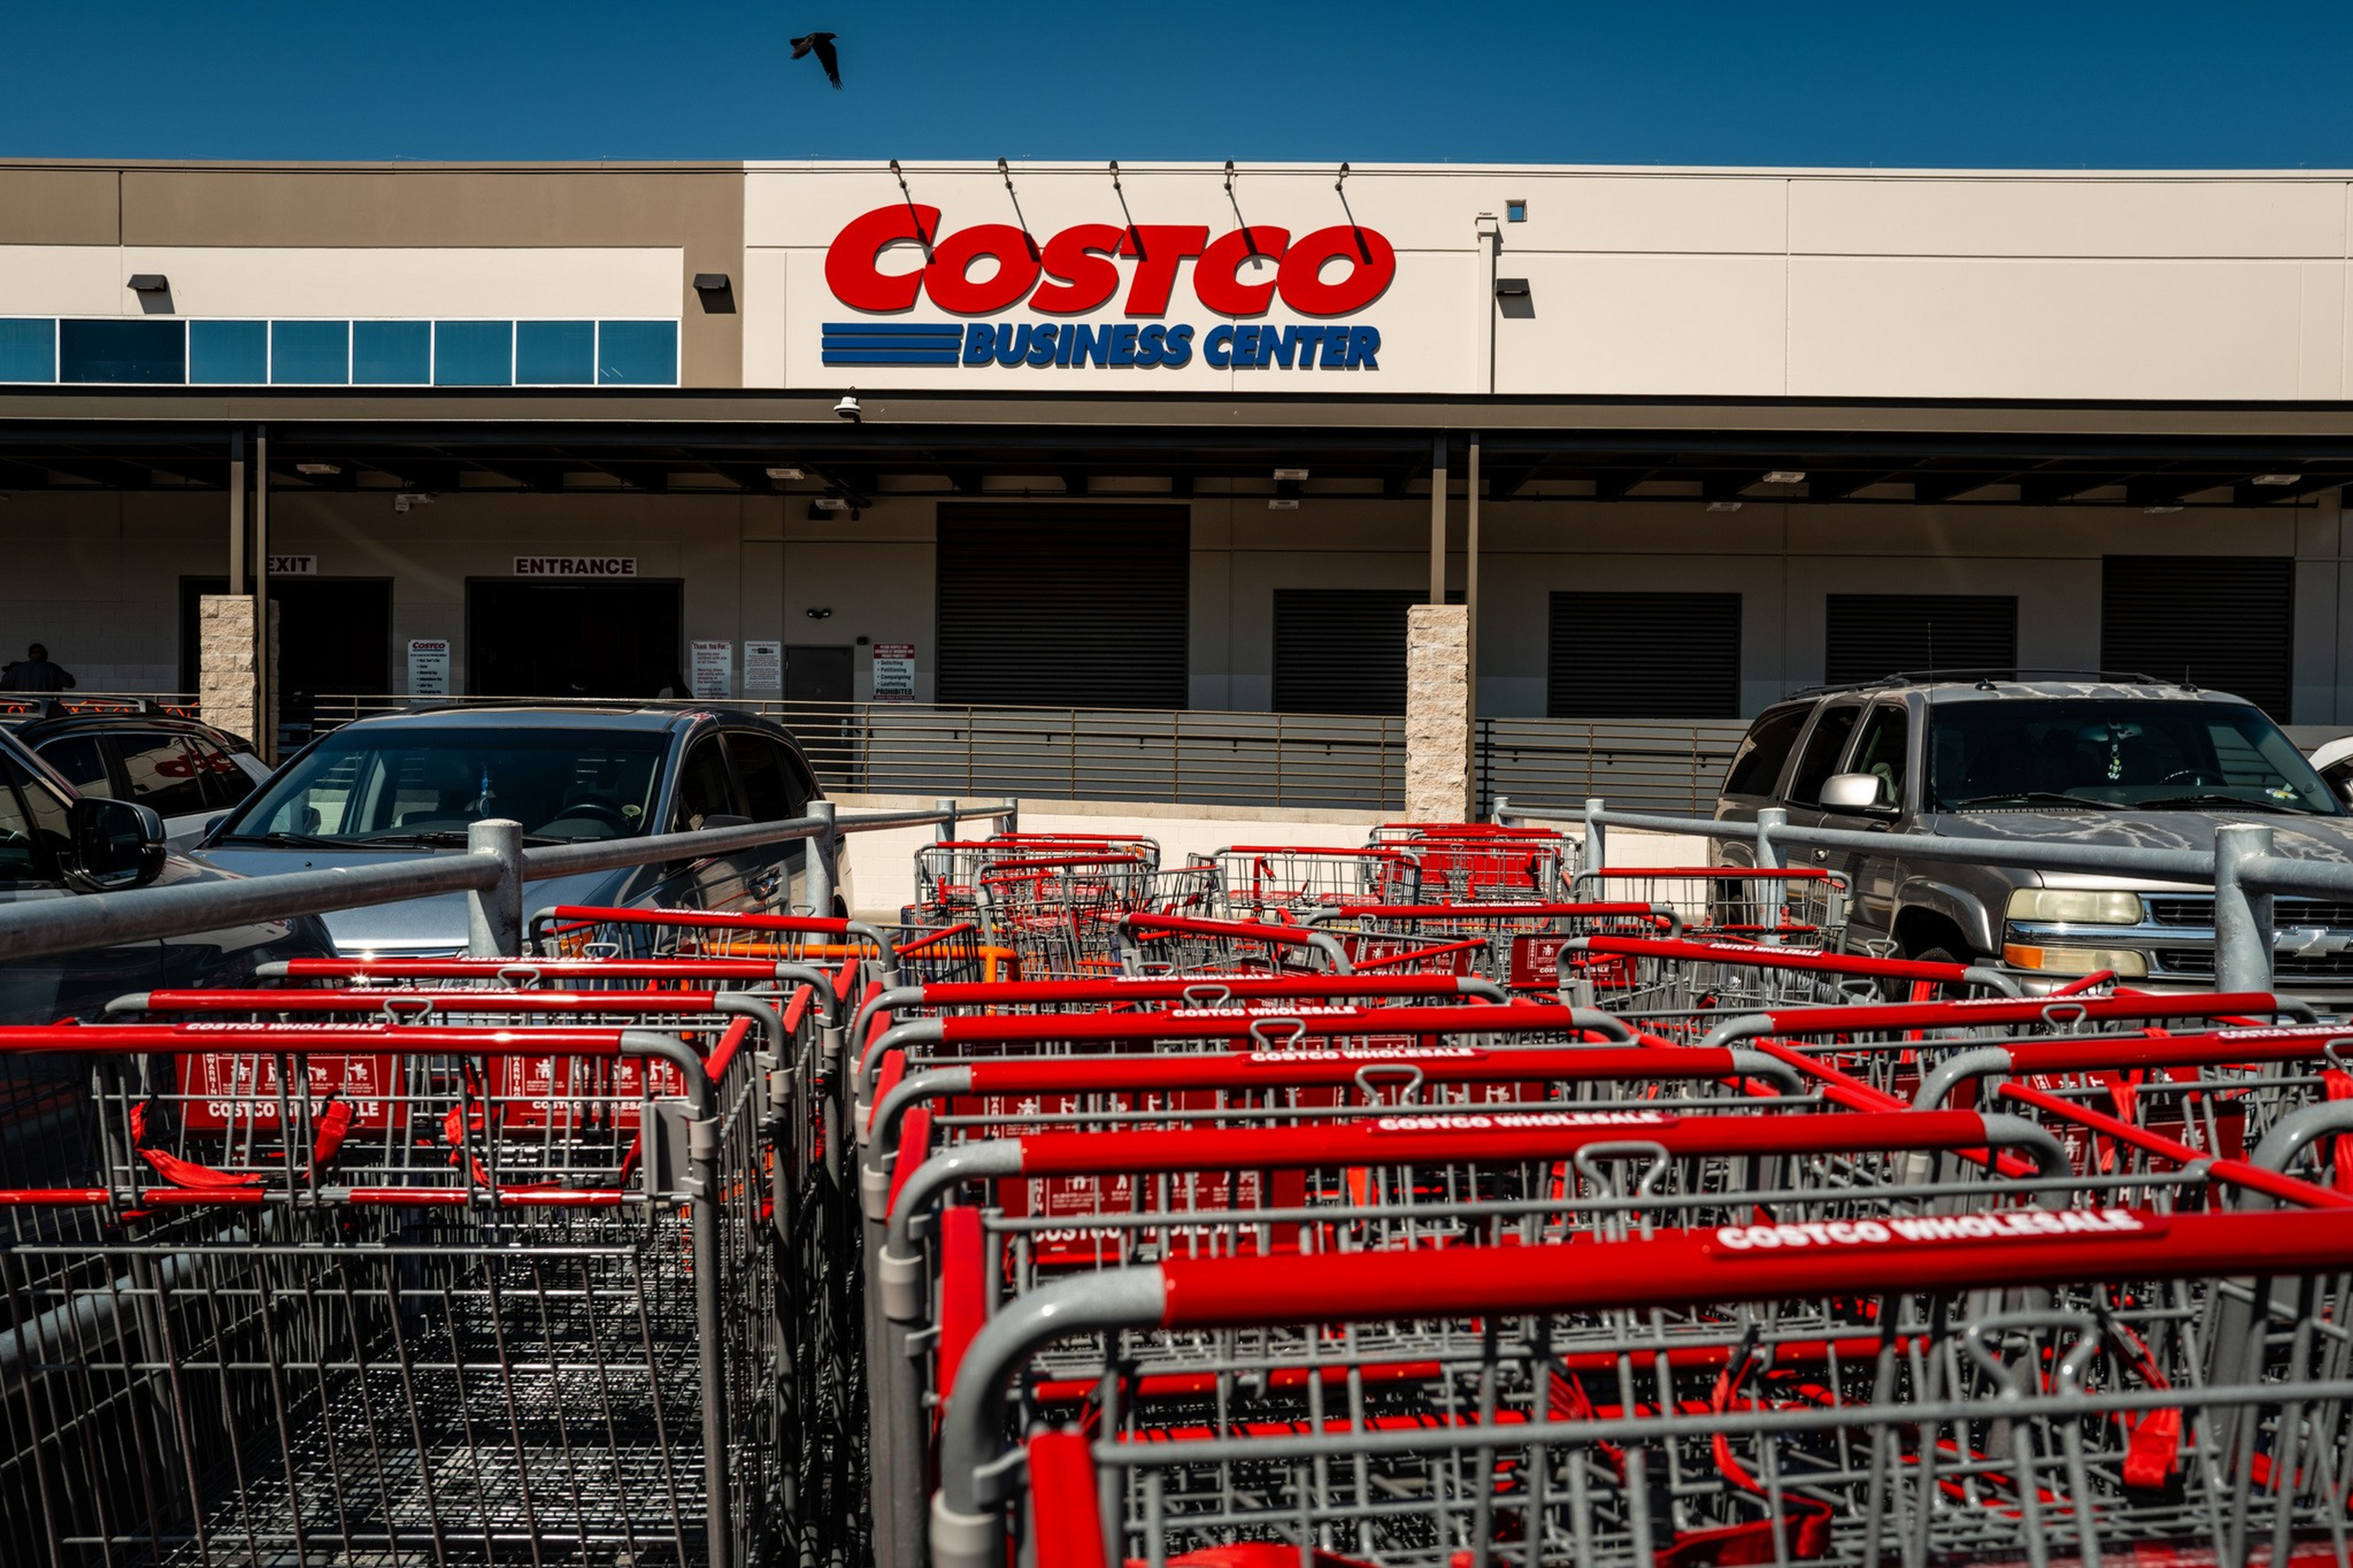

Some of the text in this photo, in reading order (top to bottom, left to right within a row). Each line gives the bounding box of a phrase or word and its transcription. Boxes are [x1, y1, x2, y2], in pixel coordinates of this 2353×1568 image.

[825, 204, 1396, 317] COSTCO
[962, 323, 1381, 371] BUSINESS CENTER
[268, 557, 311, 572] EXIT
[517, 558, 634, 574] ENTRANCE
[1754, 945, 1823, 957] WHOLESALE
[1172, 1006, 1358, 1017] COSTCO WHOLESALE
[268, 1022, 385, 1031] WHOLESALE
[1251, 1047, 1476, 1062] COSTCO WHOLESALE
[1378, 1112, 1663, 1131] COSTCO WHOLESALE
[1717, 1208, 2145, 1249] COSTCO WHOLESALE
